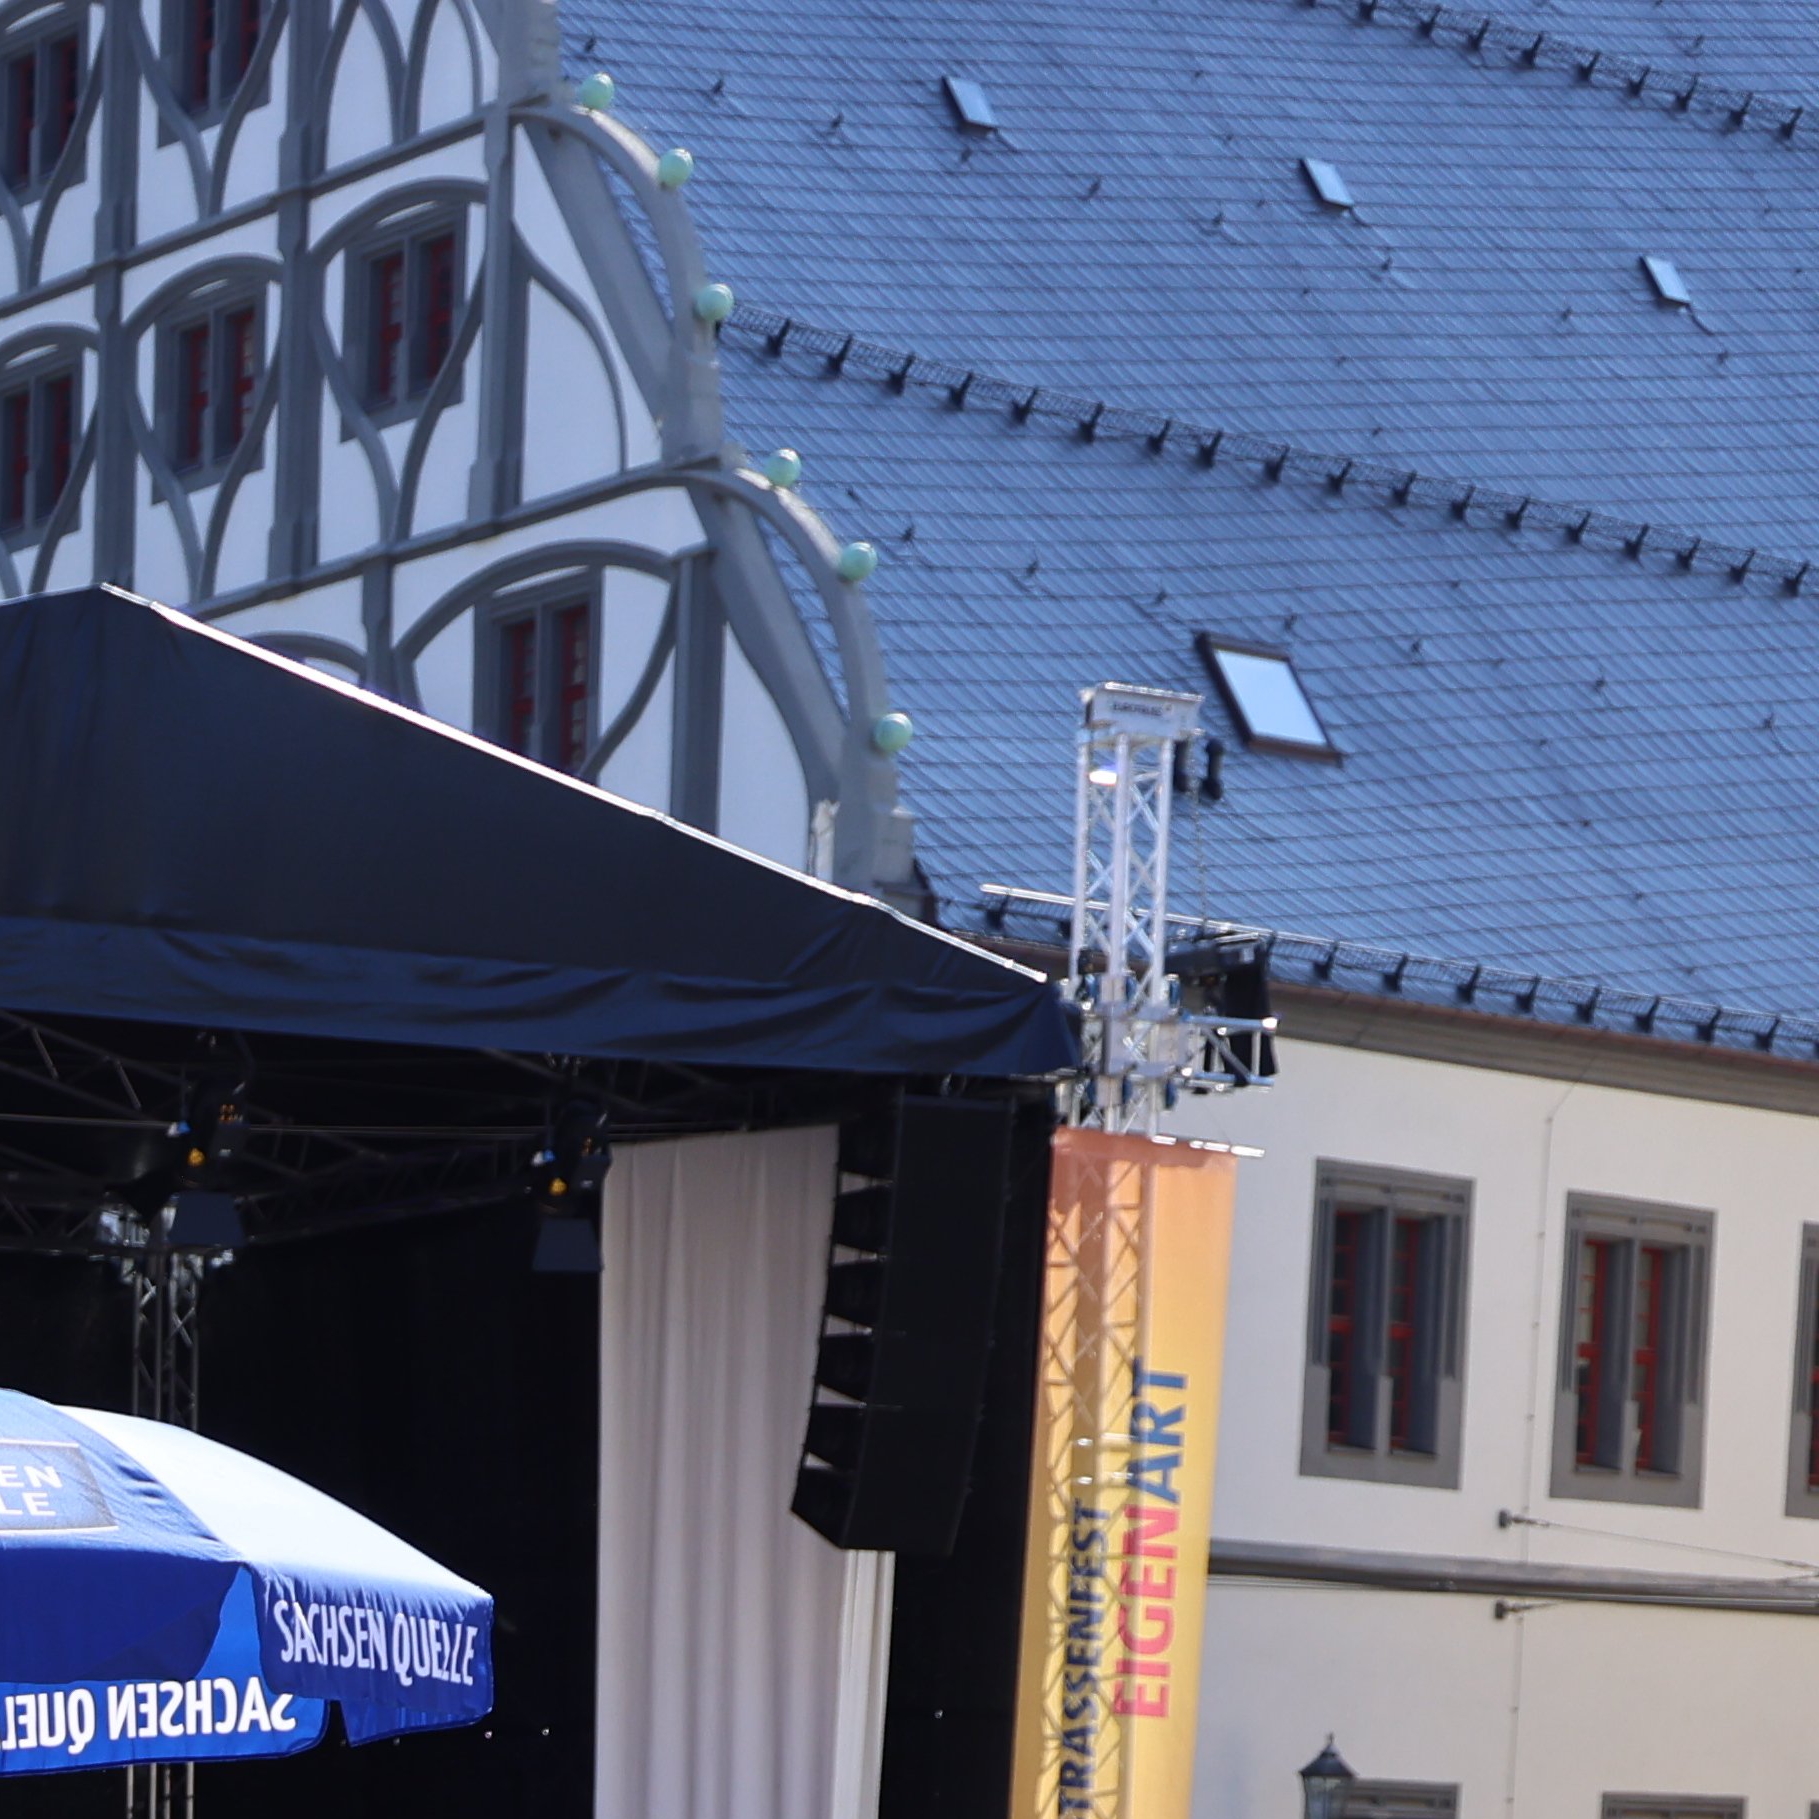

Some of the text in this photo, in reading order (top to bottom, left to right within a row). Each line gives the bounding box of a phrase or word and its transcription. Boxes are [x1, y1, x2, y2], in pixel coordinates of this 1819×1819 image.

[273, 1599, 479, 1687] SACHSEN QUELLE
[1114, 1356, 1189, 1719] EIGENART
